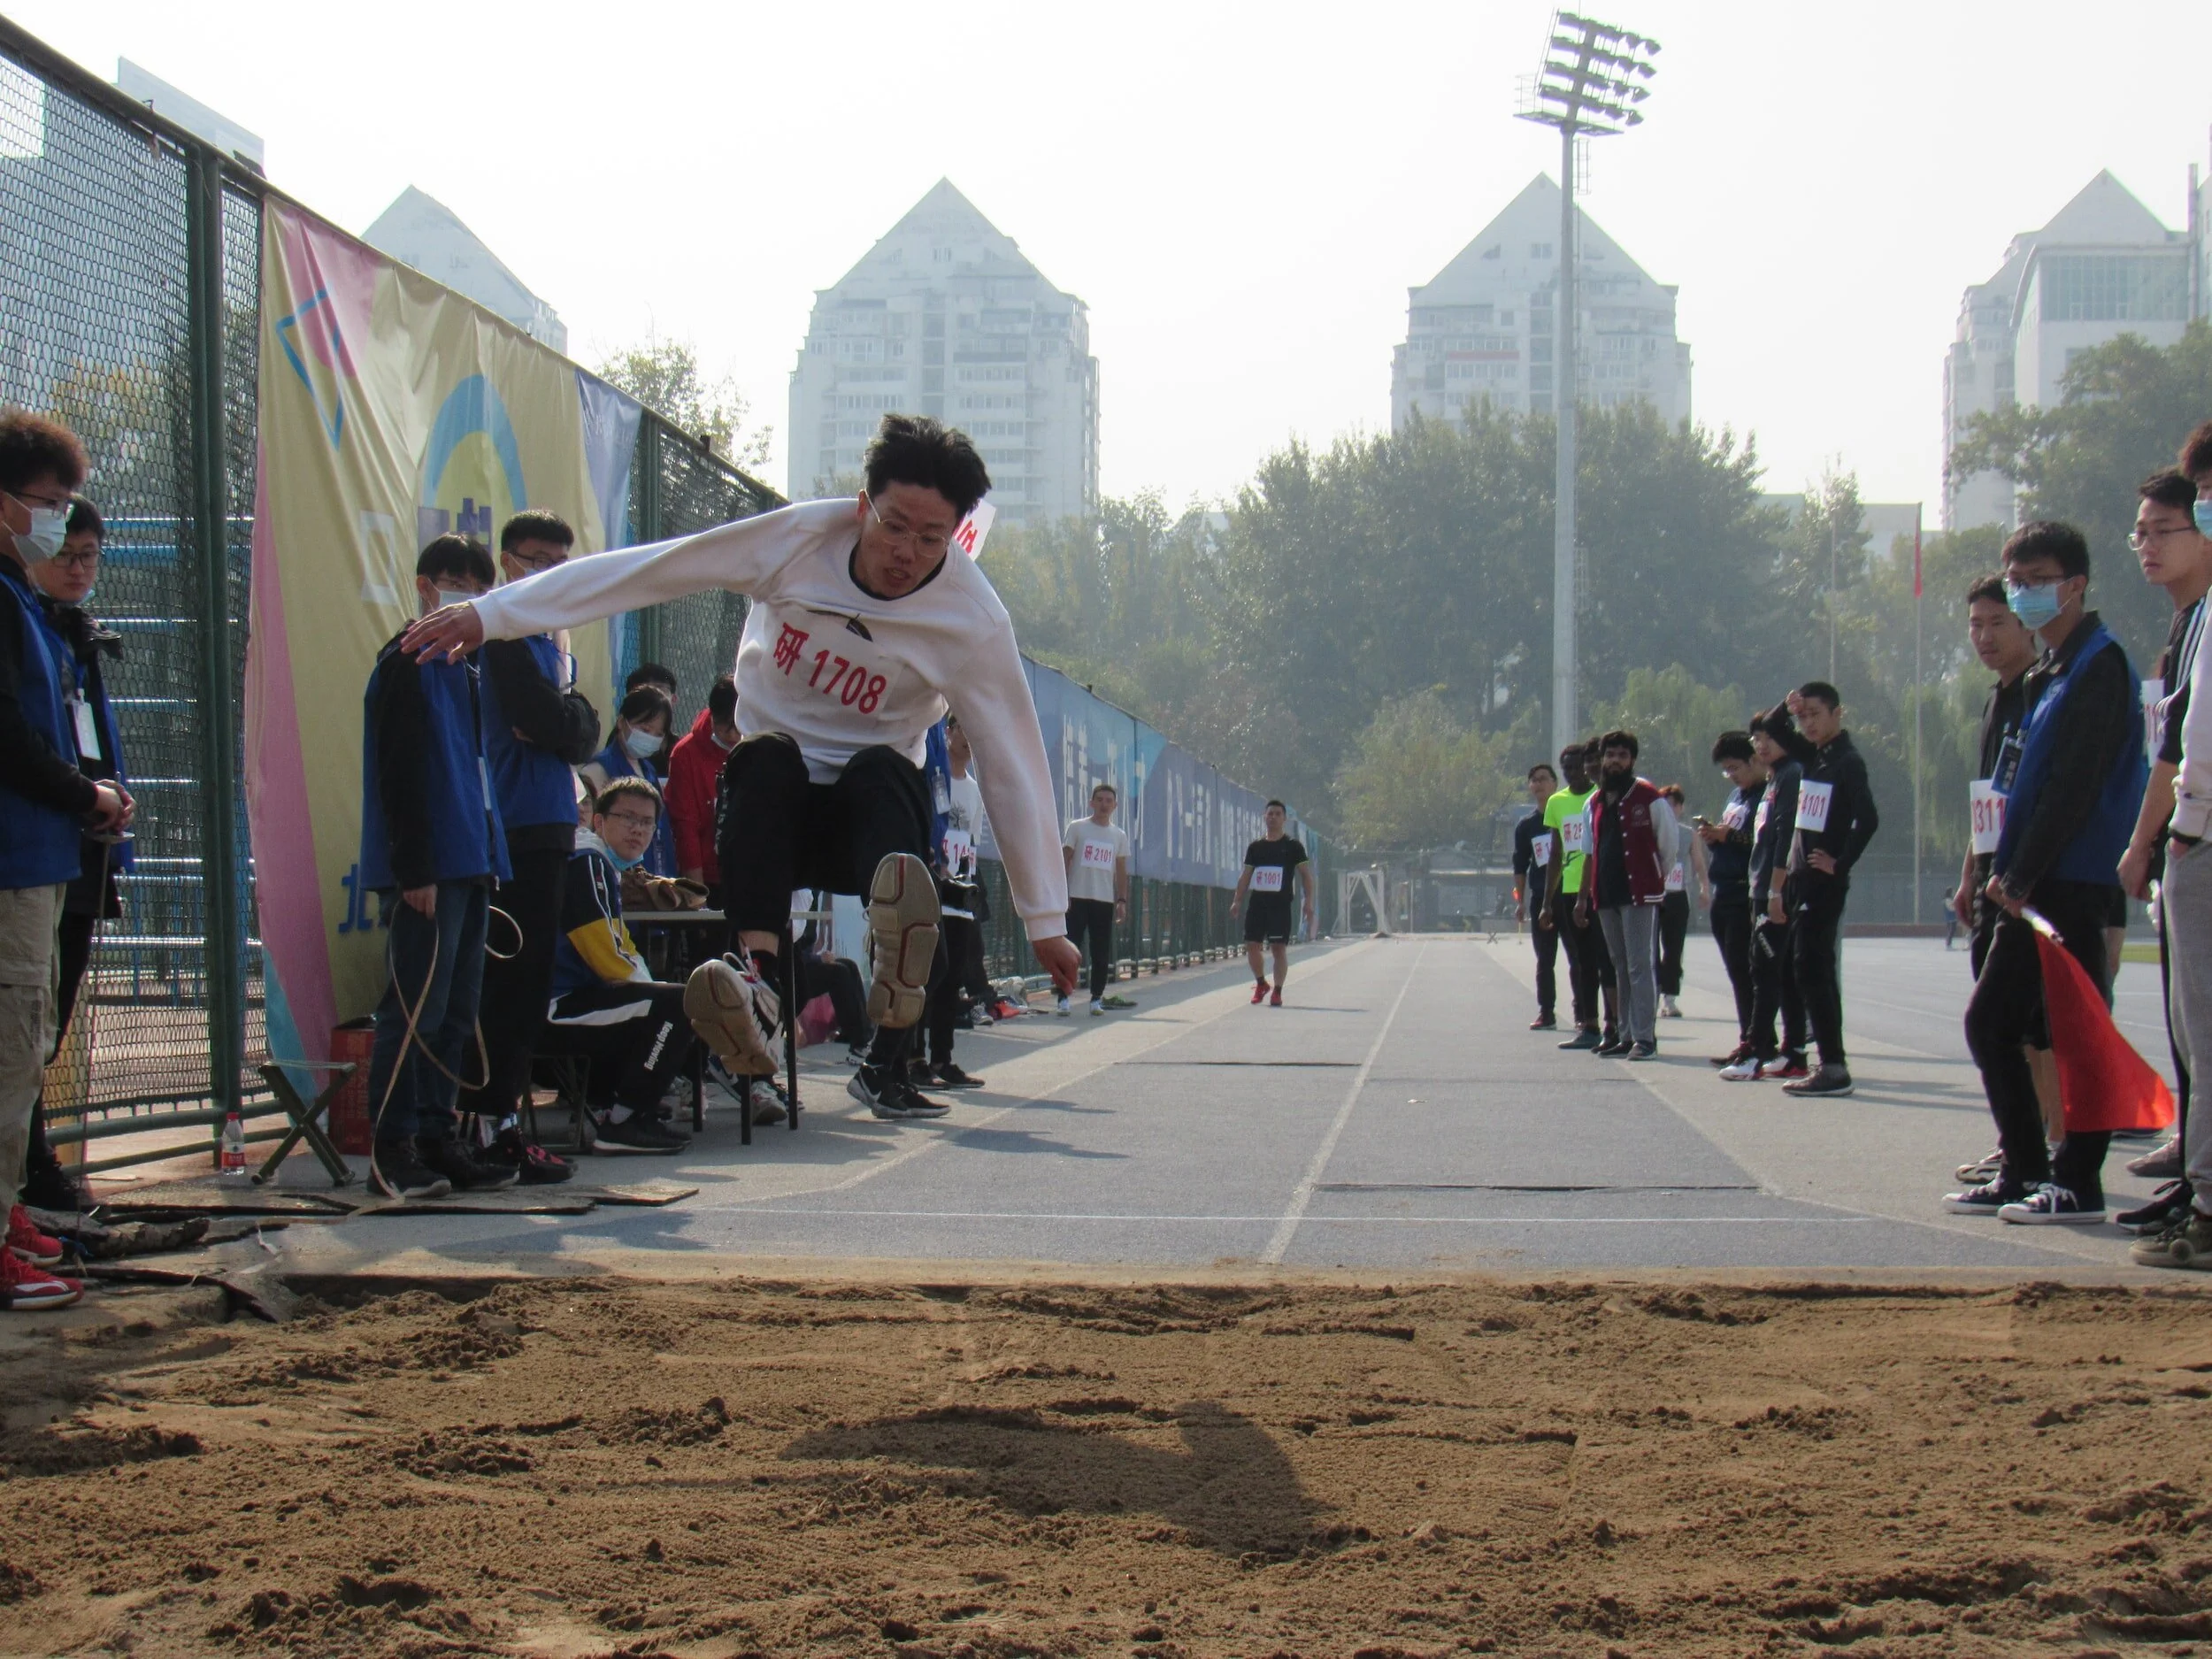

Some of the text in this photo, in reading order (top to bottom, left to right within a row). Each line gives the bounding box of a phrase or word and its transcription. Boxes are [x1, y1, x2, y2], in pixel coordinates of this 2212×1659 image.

[773, 622, 887, 715] 研 1708
[1094, 848, 1111, 864] 2101
[644, 1020, 673, 1071] Keep Moving
